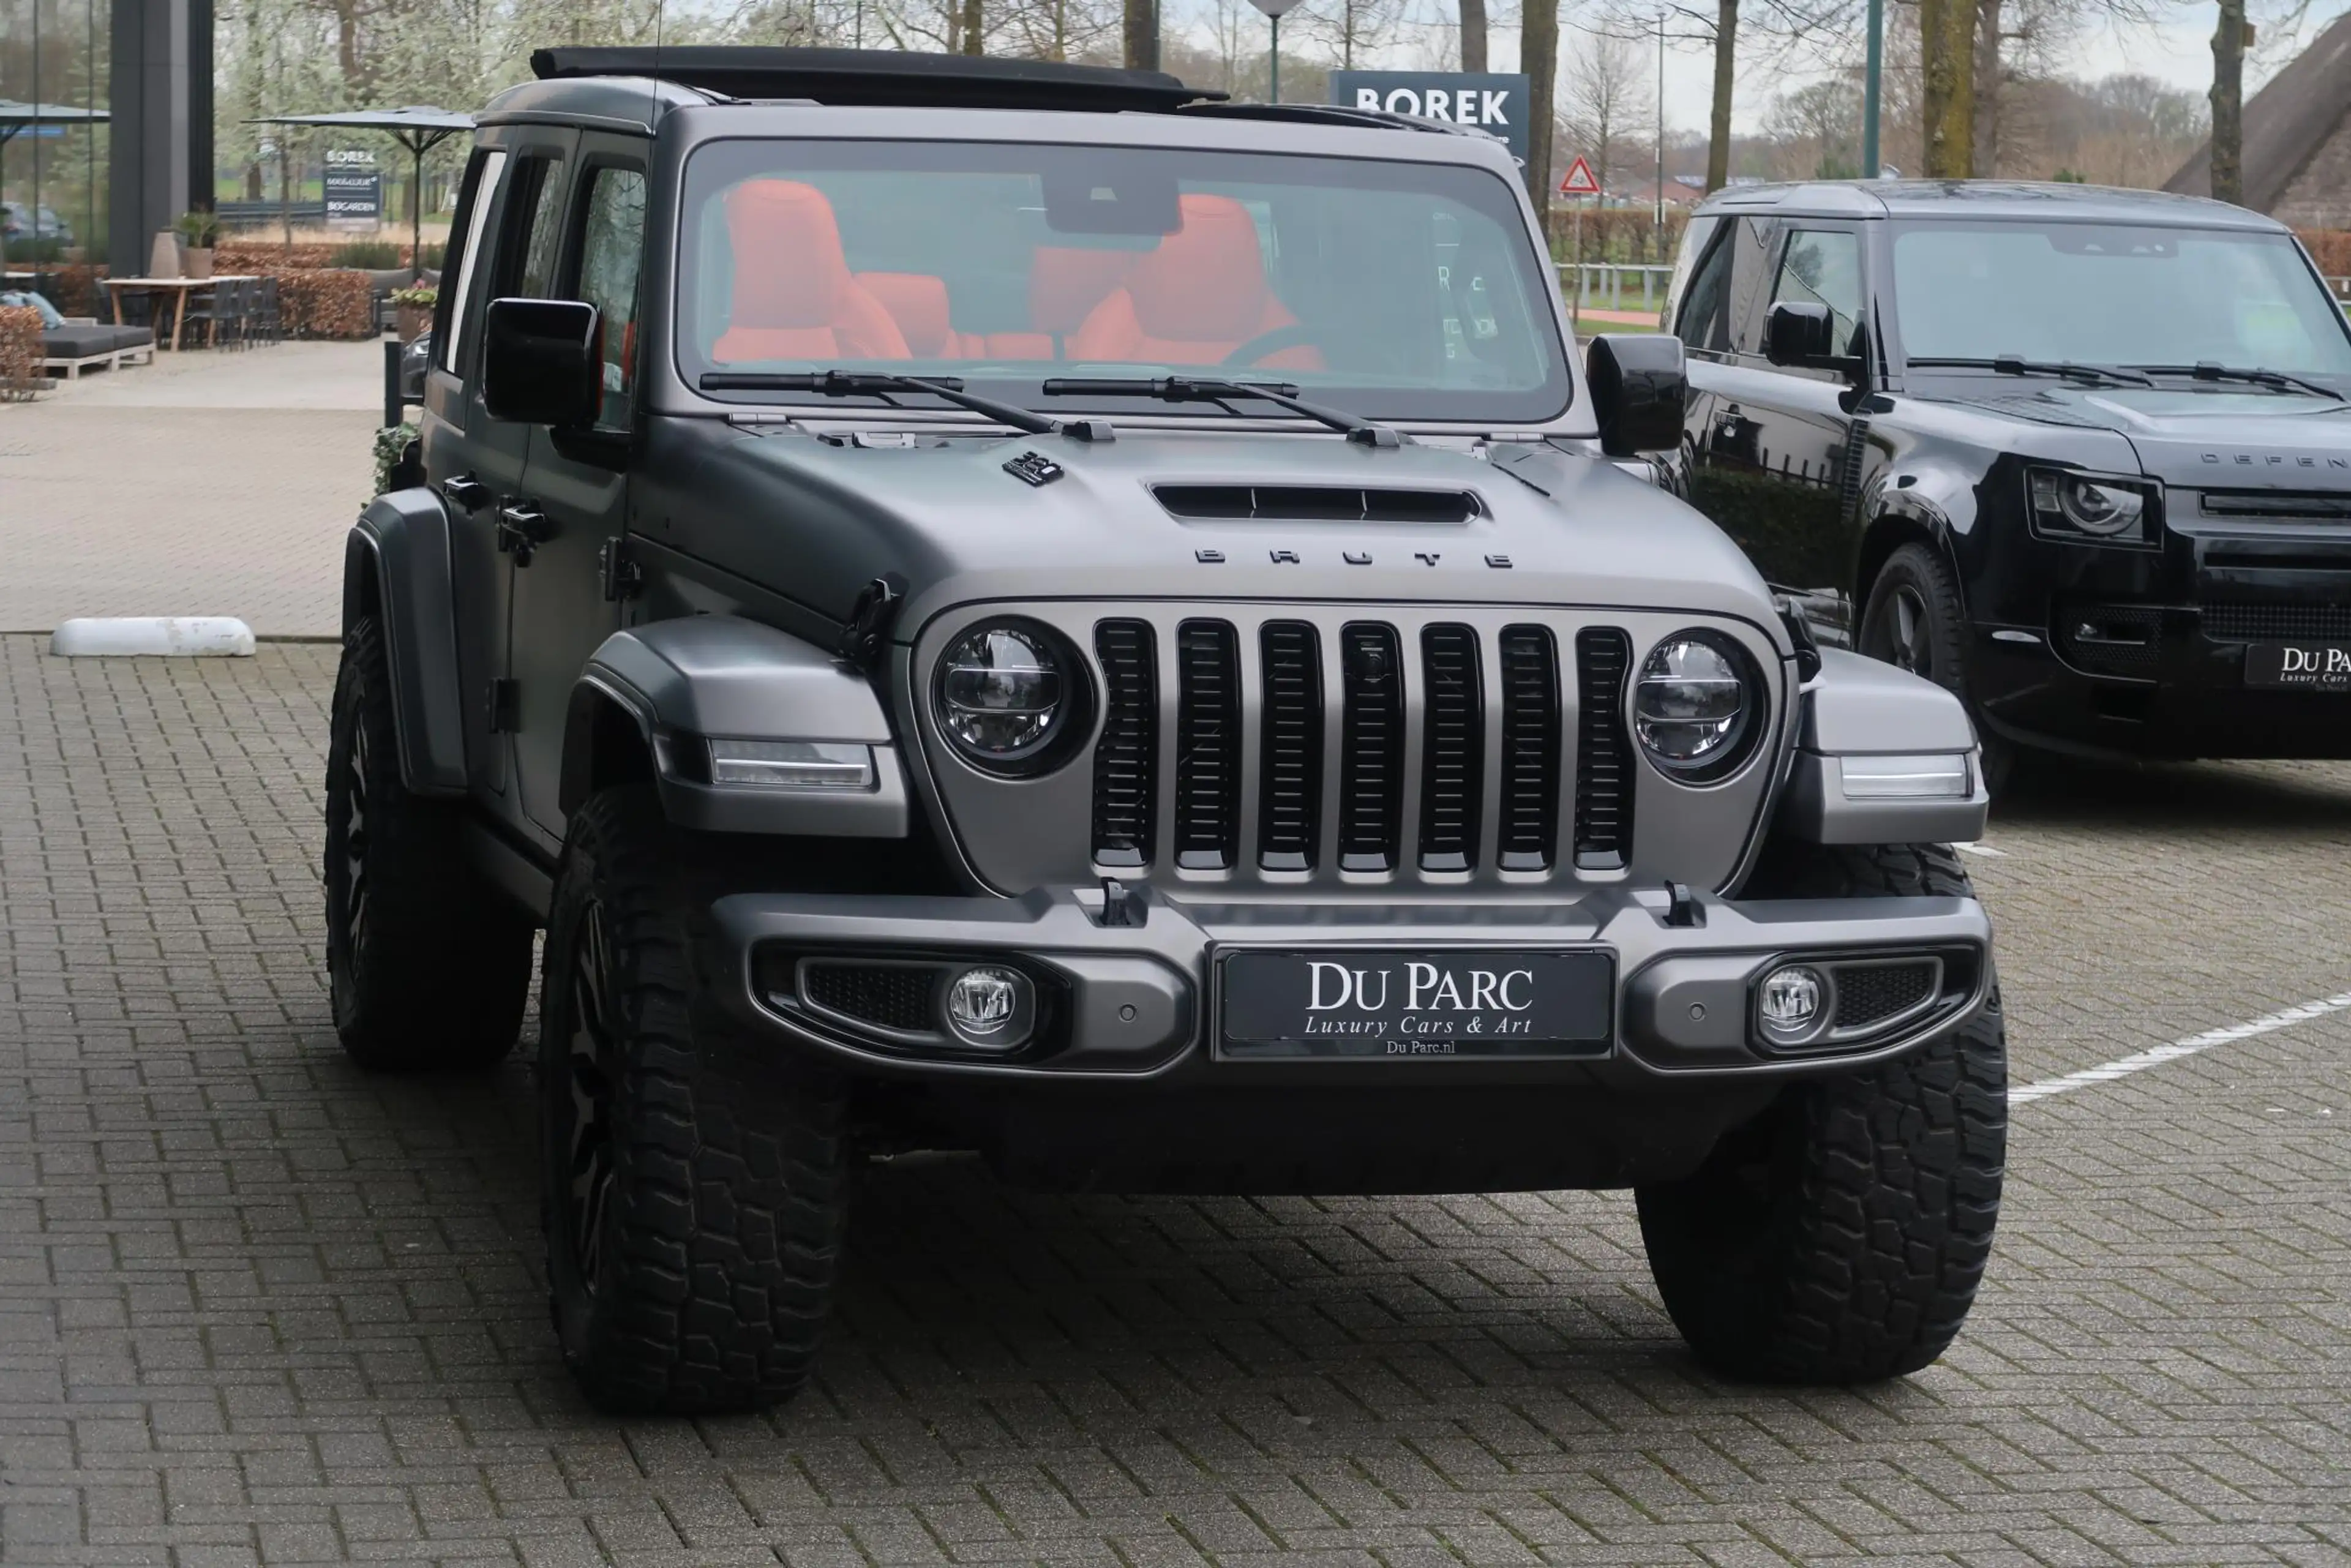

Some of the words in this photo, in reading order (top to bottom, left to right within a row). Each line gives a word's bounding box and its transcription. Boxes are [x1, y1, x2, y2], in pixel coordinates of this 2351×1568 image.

[1357, 88, 1510, 124] BOREK
[1195, 549, 1513, 568] BRUTE
[2280, 672, 2318, 684] Luxury
[2322, 673, 2347, 683] Cars
[1305, 962, 1391, 1011] DU
[1403, 962, 1533, 1011] PARC
[1305, 1016, 1388, 1038] Luxury
[1400, 1016, 1455, 1033] Cars
[1466, 1016, 1483, 1033] &
[1494, 1016, 1532, 1033] Art
[1386, 1041, 1407, 1054] Du
[1411, 1041, 1455, 1054] Parc.nl
